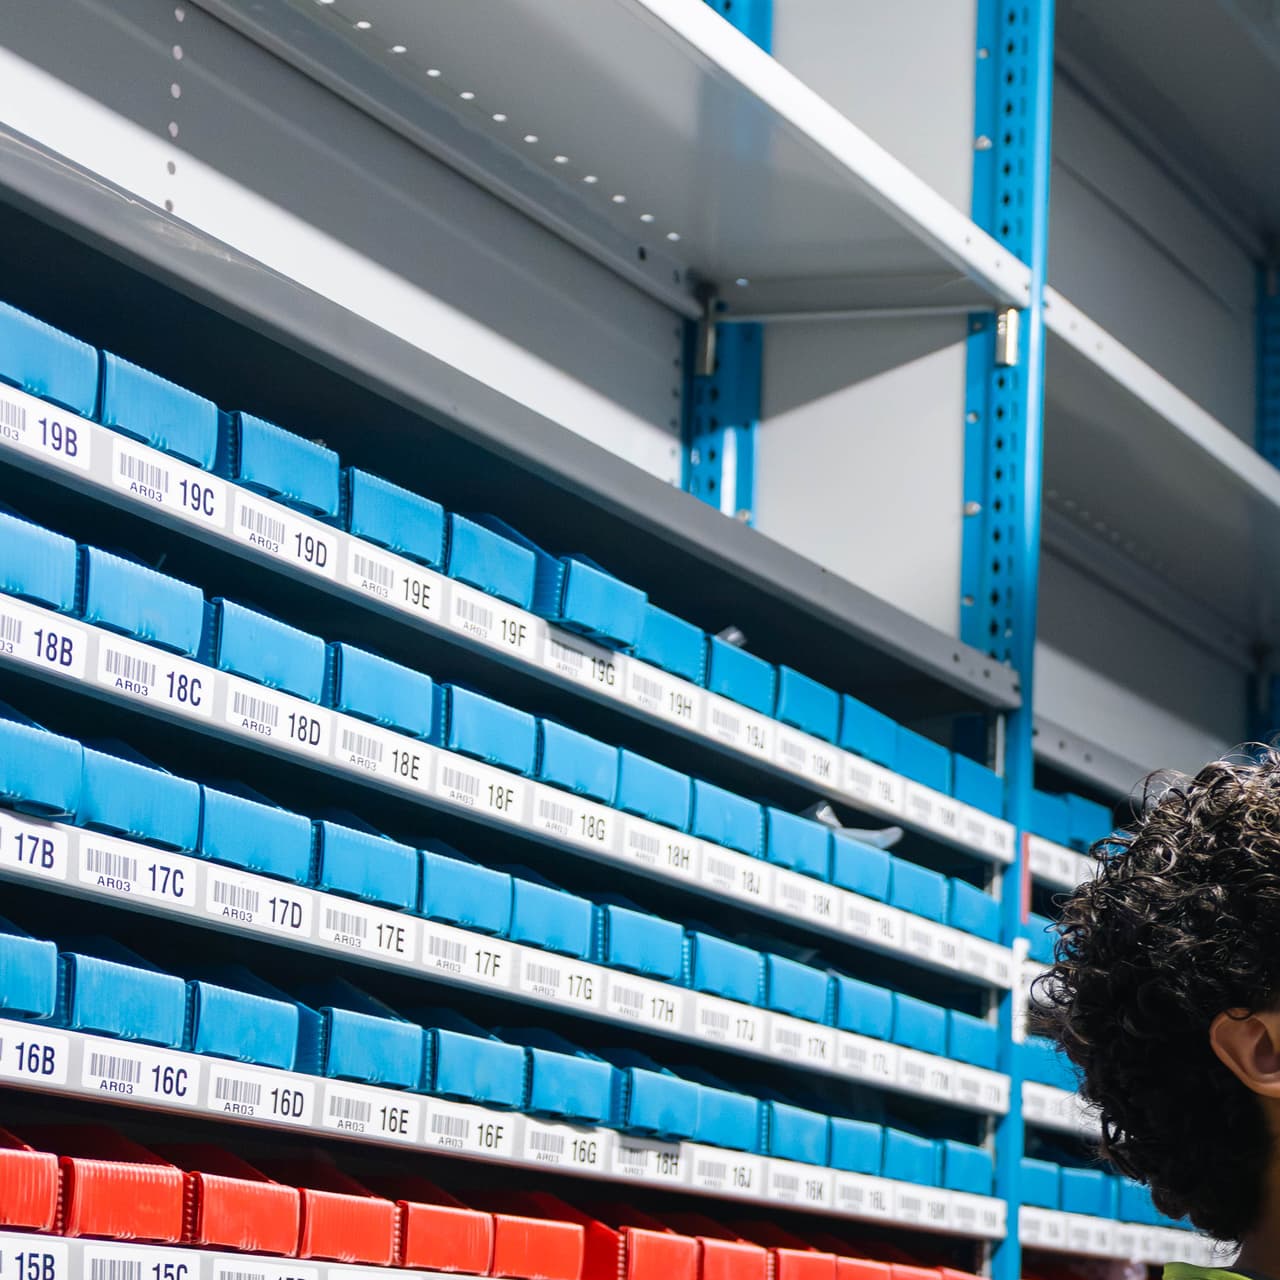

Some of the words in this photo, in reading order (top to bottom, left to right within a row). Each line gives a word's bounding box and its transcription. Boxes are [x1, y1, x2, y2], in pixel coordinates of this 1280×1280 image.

[39, 419, 77, 456] 19B
[130, 482, 162, 502] AR03
[180, 480, 214, 516] 19C
[250, 533, 278, 552] AR03
[296, 533, 326, 567] 19D
[361, 579, 389, 598] AR03
[404, 578, 430, 609] 19E
[502, 620, 526, 646] 19F
[35, 630, 72, 666] 18B
[590, 656, 615, 686] 19G
[115, 678, 148, 696] AR03
[167, 672, 201, 706] 18C
[670, 692, 691, 718] 19H
[242, 719, 271, 736] AR03
[289, 713, 320, 745] 18D
[350, 755, 376, 771] AR03
[393, 750, 420, 780] 18E
[489, 785, 513, 810] 18F
[581, 815, 604, 840] 18G
[15, 833, 54, 868] 17B
[668, 845, 689, 868] 18H
[97, 876, 130, 891] AR03
[149, 864, 183, 897] 17C
[223, 907, 252, 922] AR03
[269, 897, 302, 928] 17D
[334, 934, 361, 947] AR03
[377, 924, 404, 952] 17E
[475, 951, 501, 976] 17F
[569, 976, 592, 1000] 17G
[652, 998, 673, 1022] 17H
[16, 1043, 54, 1075] 16B
[100, 1080, 133, 1094] AR03
[152, 1065, 187, 1096] 16C
[224, 1103, 253, 1115] AR03
[272, 1088, 303, 1117] 16D
[337, 1120, 364, 1132] AR03
[381, 1107, 408, 1134] 16E
[478, 1124, 503, 1148] 16F
[573, 1140, 596, 1163] 16G
